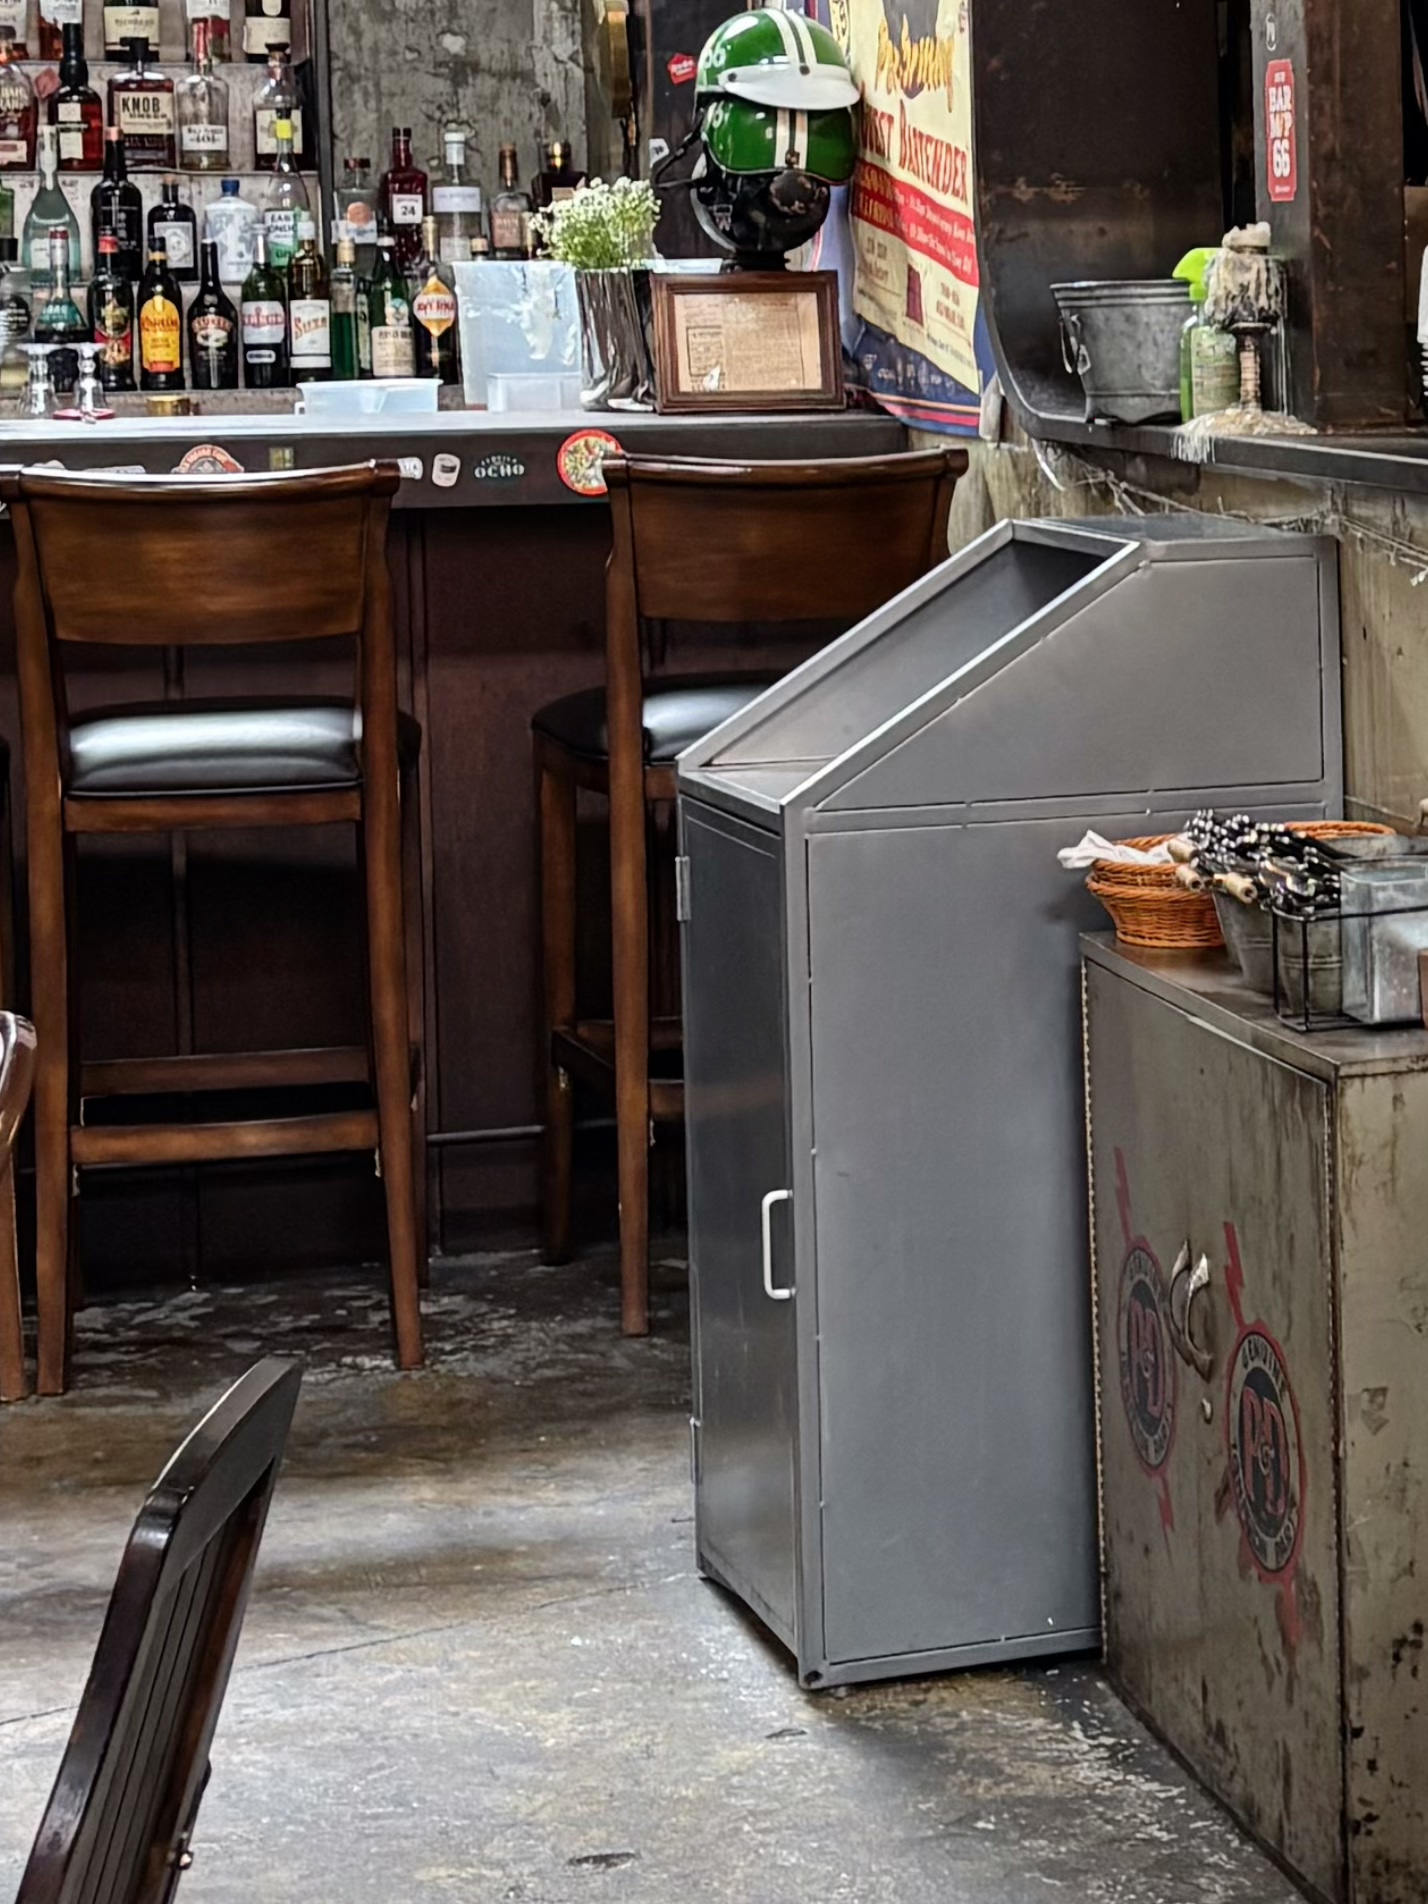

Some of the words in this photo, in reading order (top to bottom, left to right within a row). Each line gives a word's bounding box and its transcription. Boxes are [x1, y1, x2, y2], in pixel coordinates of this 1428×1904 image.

[121, 96, 161, 114] KNOB
[401, 205, 416, 217] 24
[474, 463, 526, 479] OCHO
